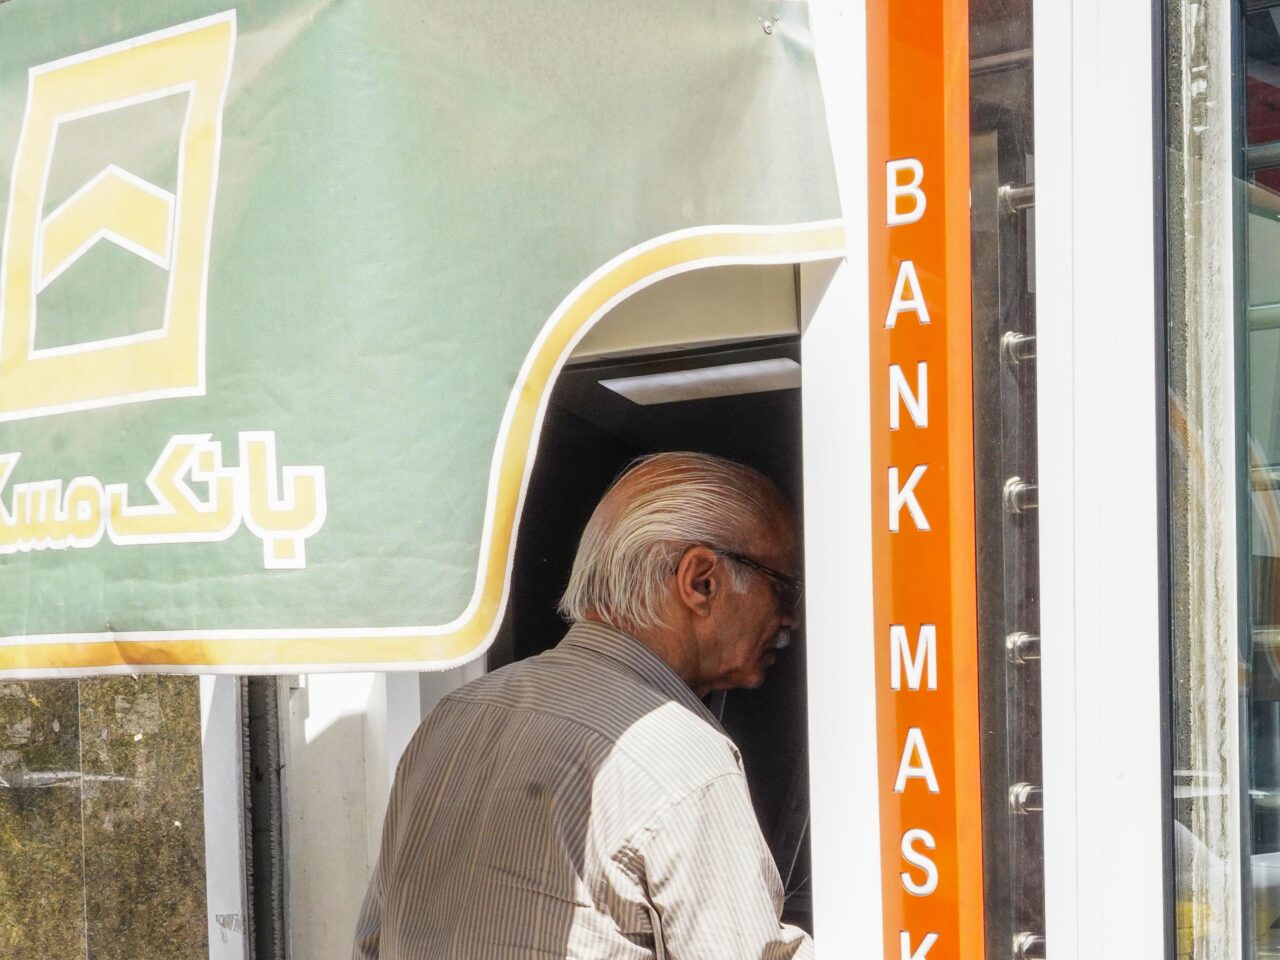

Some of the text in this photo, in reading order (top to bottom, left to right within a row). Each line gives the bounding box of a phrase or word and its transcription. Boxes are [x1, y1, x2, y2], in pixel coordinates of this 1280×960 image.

[883, 156, 932, 533] BANK
[0, 430, 328, 570] بانک مس
